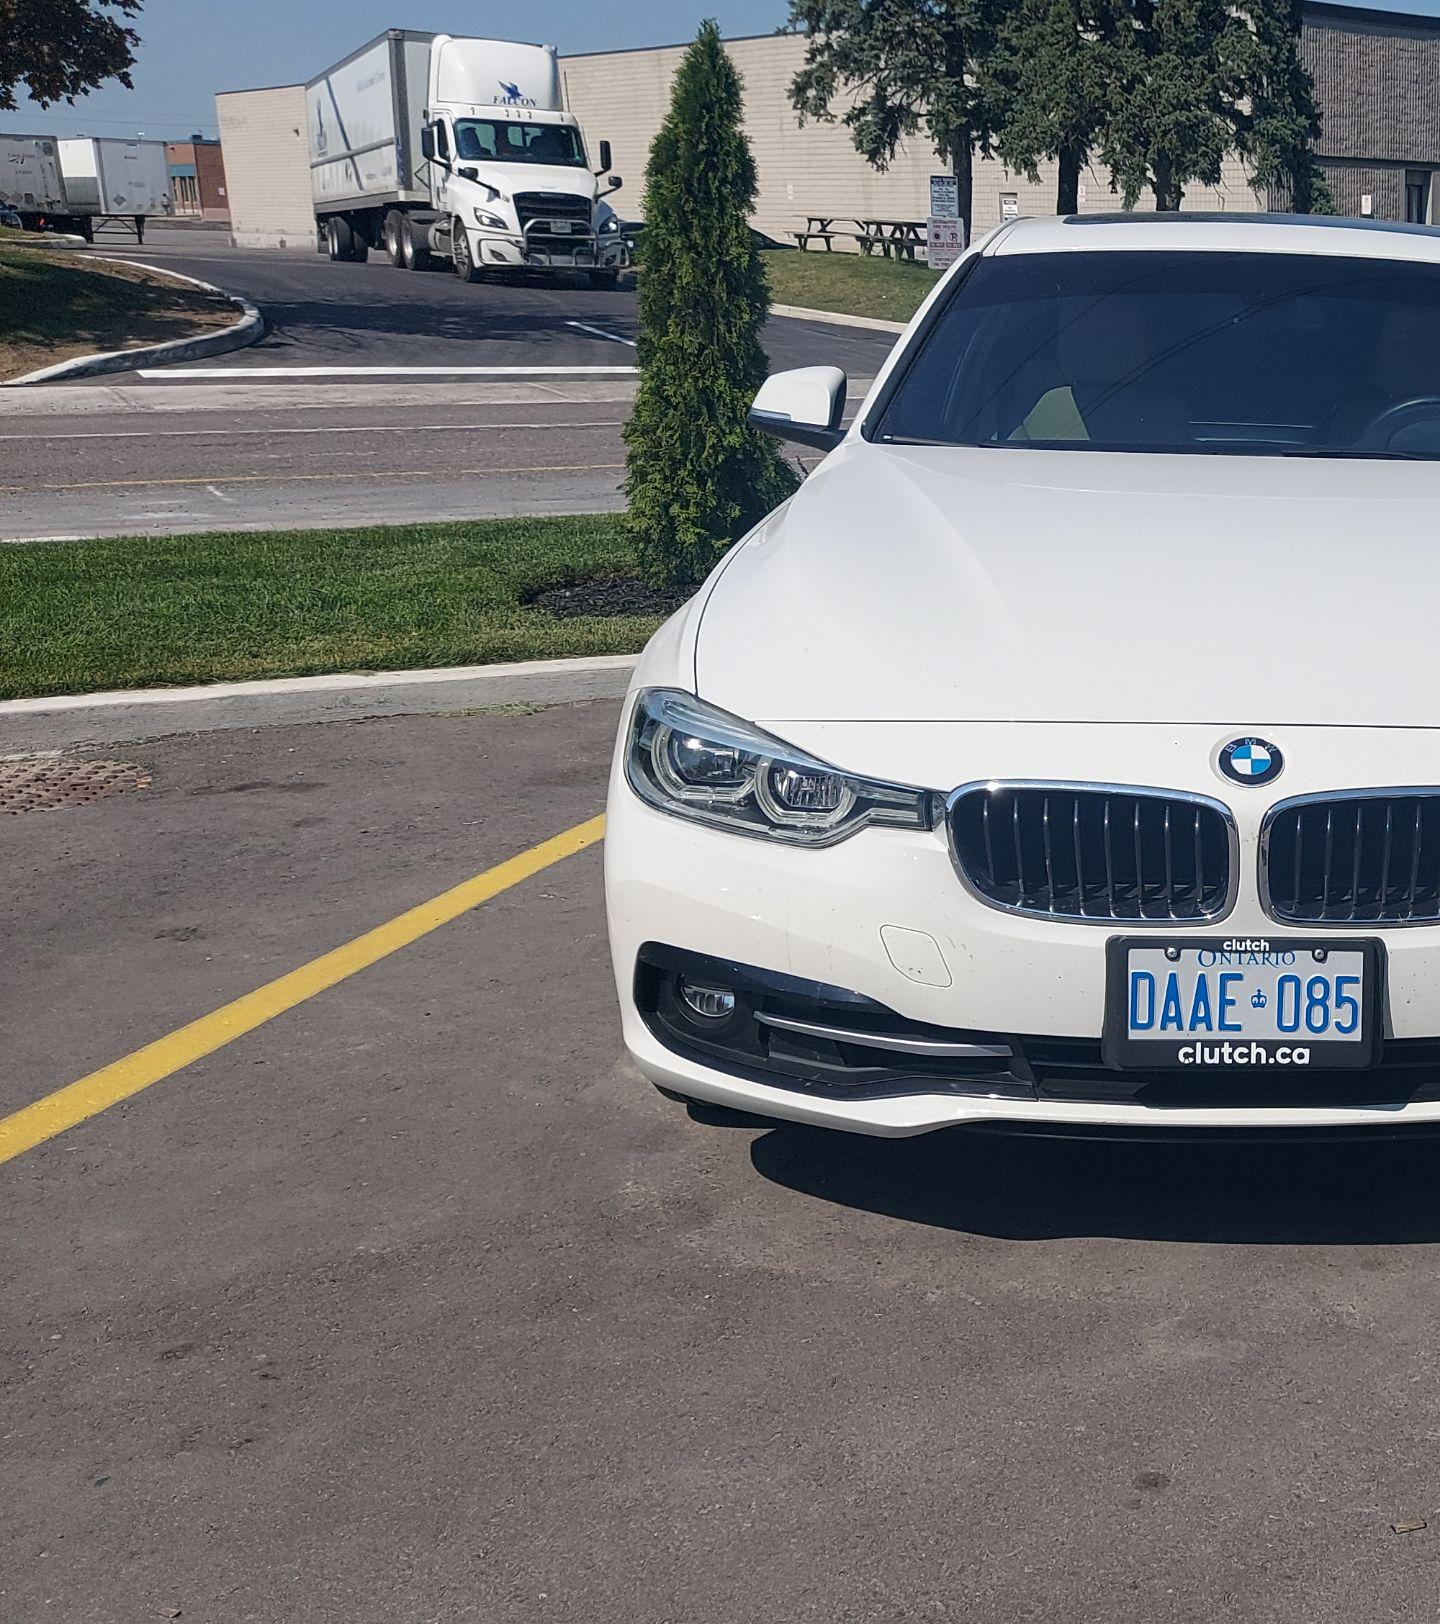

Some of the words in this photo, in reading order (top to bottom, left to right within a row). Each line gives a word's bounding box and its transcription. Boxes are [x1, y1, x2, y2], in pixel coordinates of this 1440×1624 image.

[493, 95, 537, 107] FALCON
[1225, 739, 1277, 752] BMW
[1223, 939, 1270, 951] clutch
[1198, 949, 1296, 968] ONTARIO
[1130, 971, 1243, 1031] DAAE
[1277, 974, 1360, 1034] 085
[1178, 1042, 1310, 1064] clutch.ca
